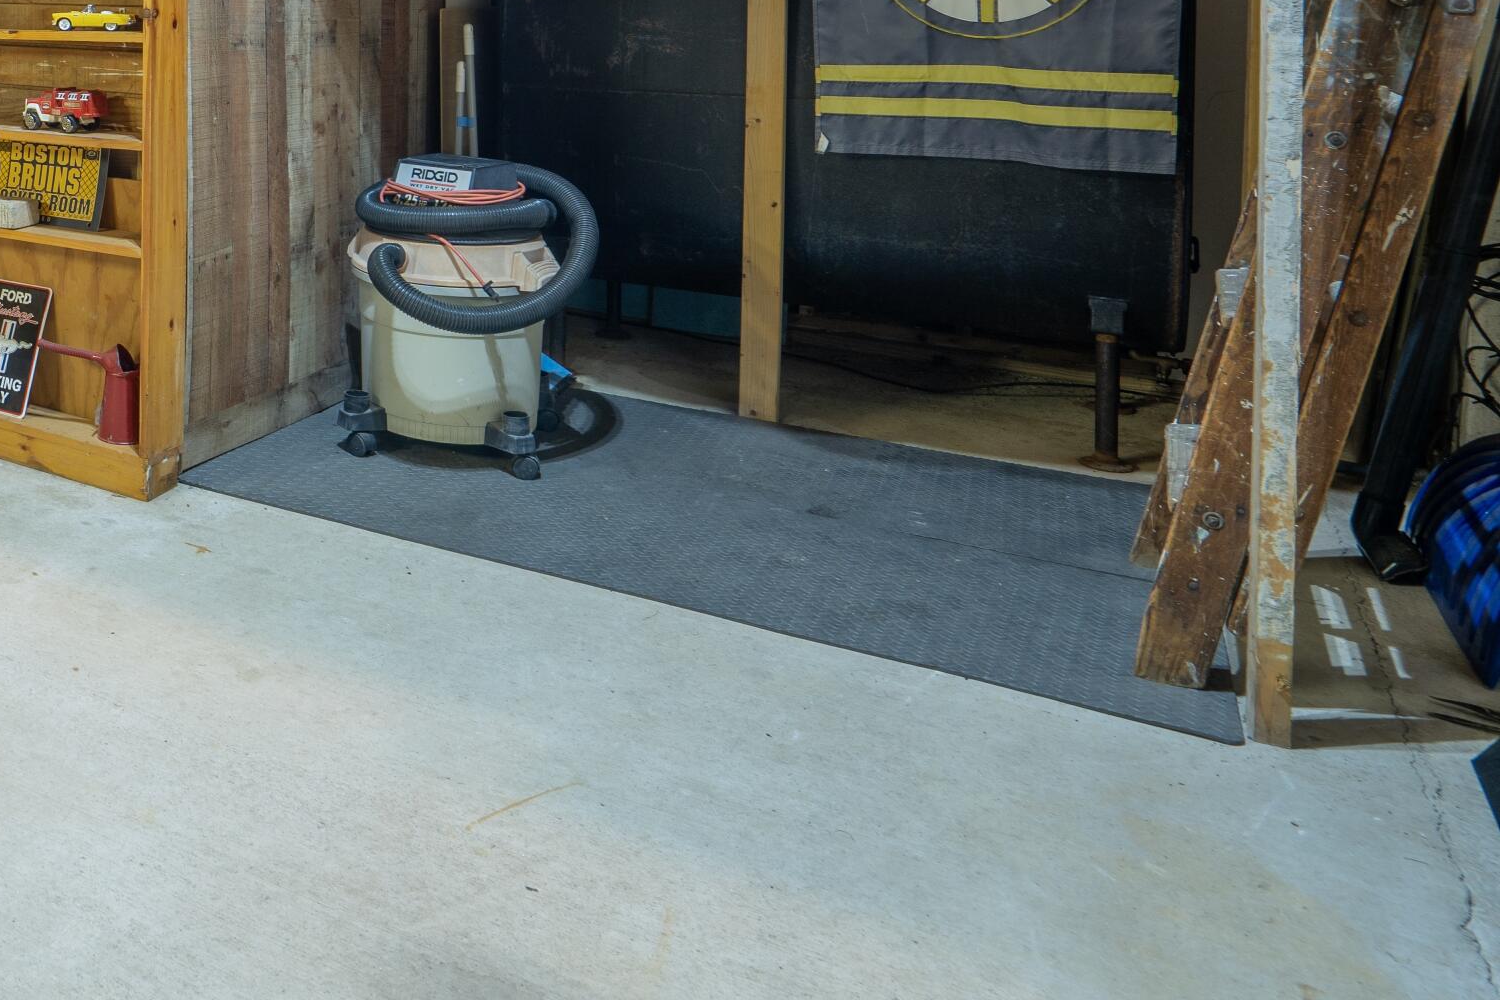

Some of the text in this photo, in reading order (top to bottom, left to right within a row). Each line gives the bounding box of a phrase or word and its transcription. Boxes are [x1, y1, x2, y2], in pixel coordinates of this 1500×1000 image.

[10, 142, 84, 167] BOSTON
[7, 161, 82, 196] BRUINS
[411, 168, 459, 183] RIDGID
[49, 196, 91, 216] ROOM
[0, 288, 32, 305] FORD
